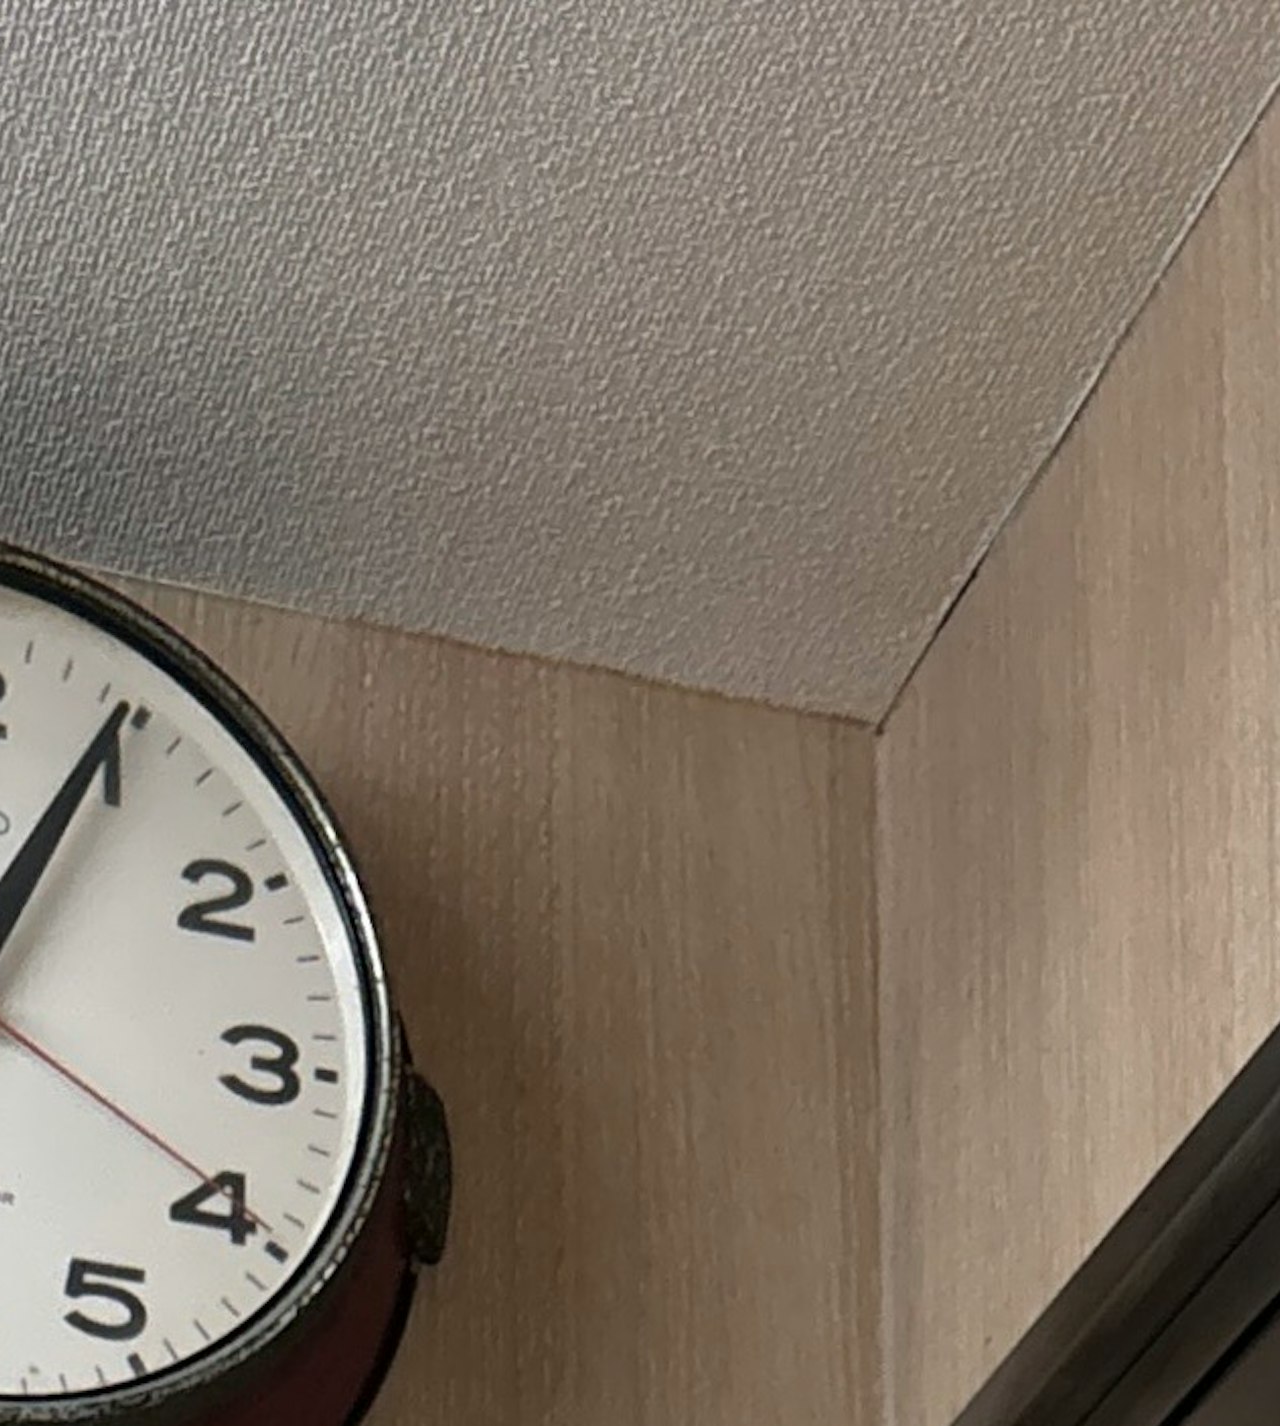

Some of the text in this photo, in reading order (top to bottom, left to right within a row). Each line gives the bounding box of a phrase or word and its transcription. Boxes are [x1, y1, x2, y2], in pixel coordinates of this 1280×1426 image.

[176, 858, 257, 942] 2
[219, 1024, 301, 1107] 3
[168, 1168, 259, 1248] 4
[63, 1256, 148, 1342] 5
